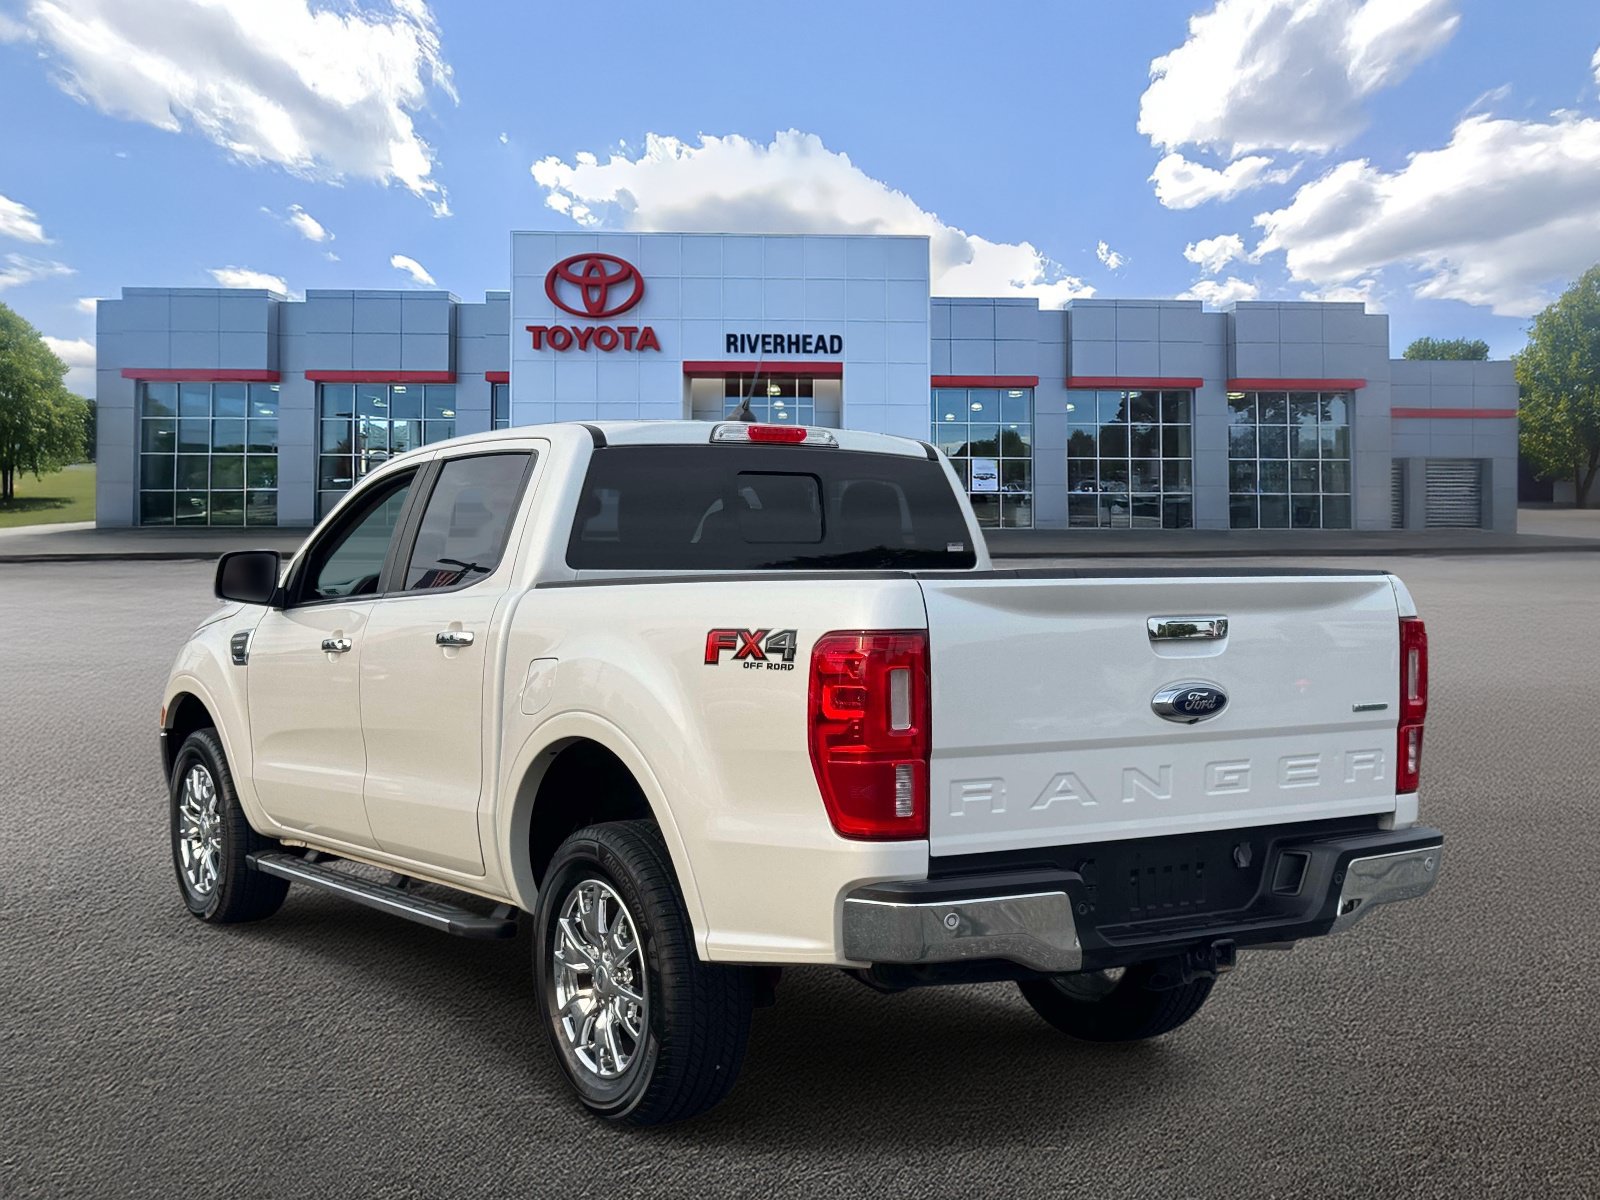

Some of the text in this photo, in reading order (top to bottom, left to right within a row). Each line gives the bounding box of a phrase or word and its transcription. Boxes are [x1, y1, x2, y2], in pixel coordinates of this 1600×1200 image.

[526, 326, 660, 352] TOYOTA
[726, 334, 842, 354] RIVERHEAD
[705, 628, 797, 664] FX4
[743, 661, 794, 671] OFF ROAD
[1184, 692, 1216, 711] Ford
[950, 749, 1385, 816] RANGER
